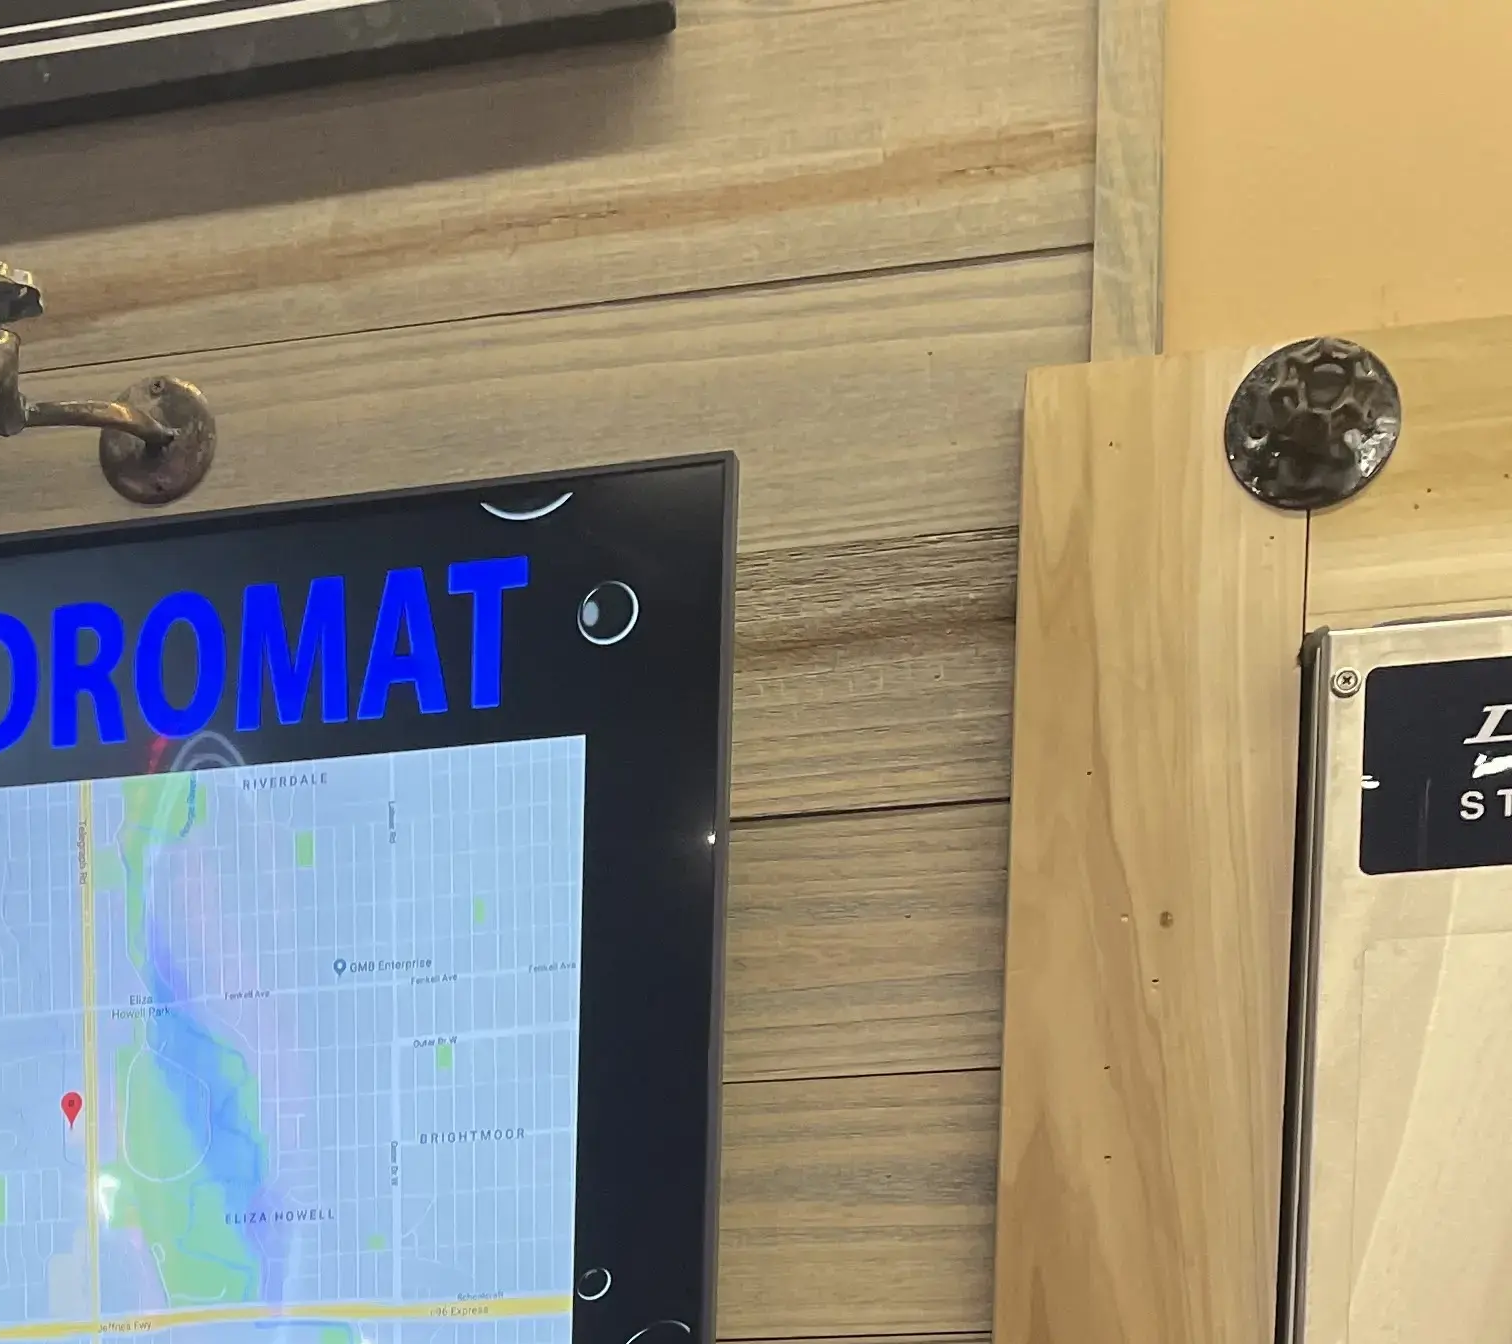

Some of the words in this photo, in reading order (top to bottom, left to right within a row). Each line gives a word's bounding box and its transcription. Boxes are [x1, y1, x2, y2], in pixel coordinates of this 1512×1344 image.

[242, 772, 328, 790] RIVERDALE
[378, 958, 432, 971] Enterprise
[420, 1128, 525, 1144] BRIGHTMOOR
[225, 1212, 267, 1225] ELIZA
[274, 1208, 335, 1222] HOWELL
